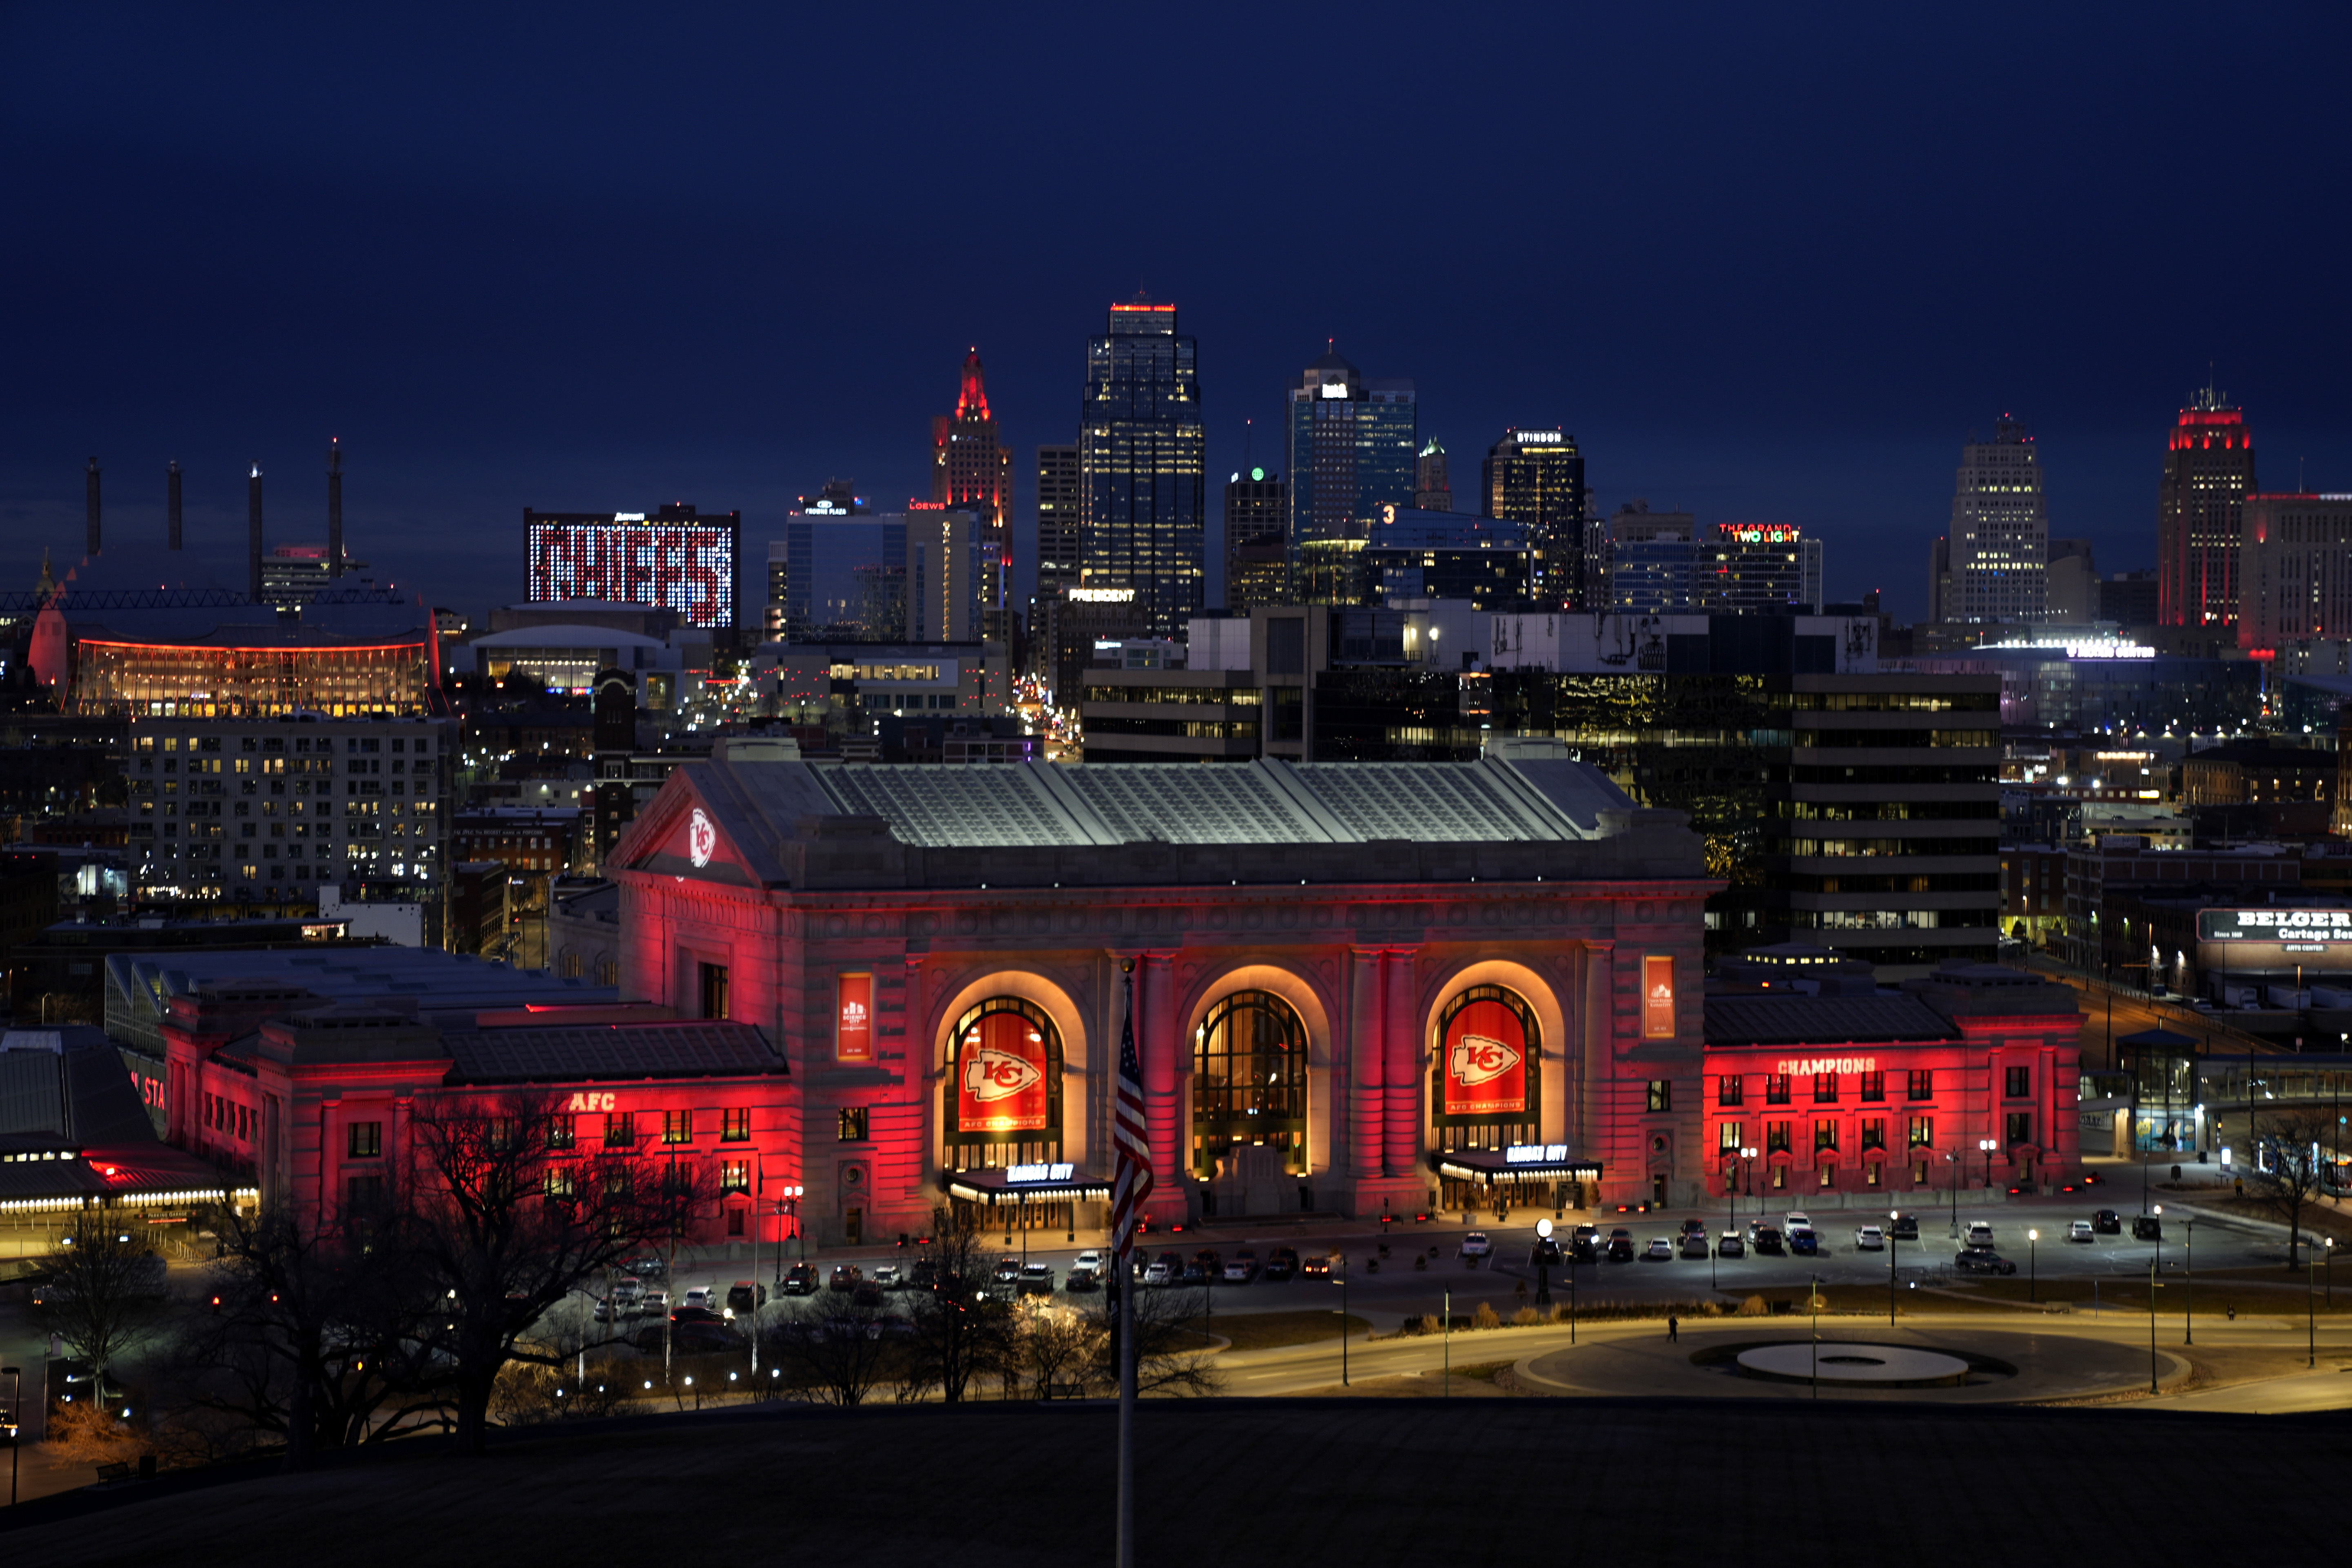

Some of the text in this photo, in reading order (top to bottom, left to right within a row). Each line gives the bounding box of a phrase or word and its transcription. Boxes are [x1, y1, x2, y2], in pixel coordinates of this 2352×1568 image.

[1517, 433, 1561, 442] STINSON
[1383, 505, 1394, 524] 3
[1732, 531, 1799, 543] TWO LIGHT
[1069, 589, 1135, 602] PRESIDENT
[2237, 912, 2351, 926] BELGER
[2279, 928, 2330, 942] Cartage
[1467, 1046, 1503, 1072] KC
[1778, 1057, 1875, 1076] CHAMPIONS
[983, 1061, 1023, 1088] KC
[569, 1092, 615, 1111] AFC
[1507, 1145, 1567, 1163] KANSAS CITY
[1008, 1163, 1074, 1182] KANSAS CITY
